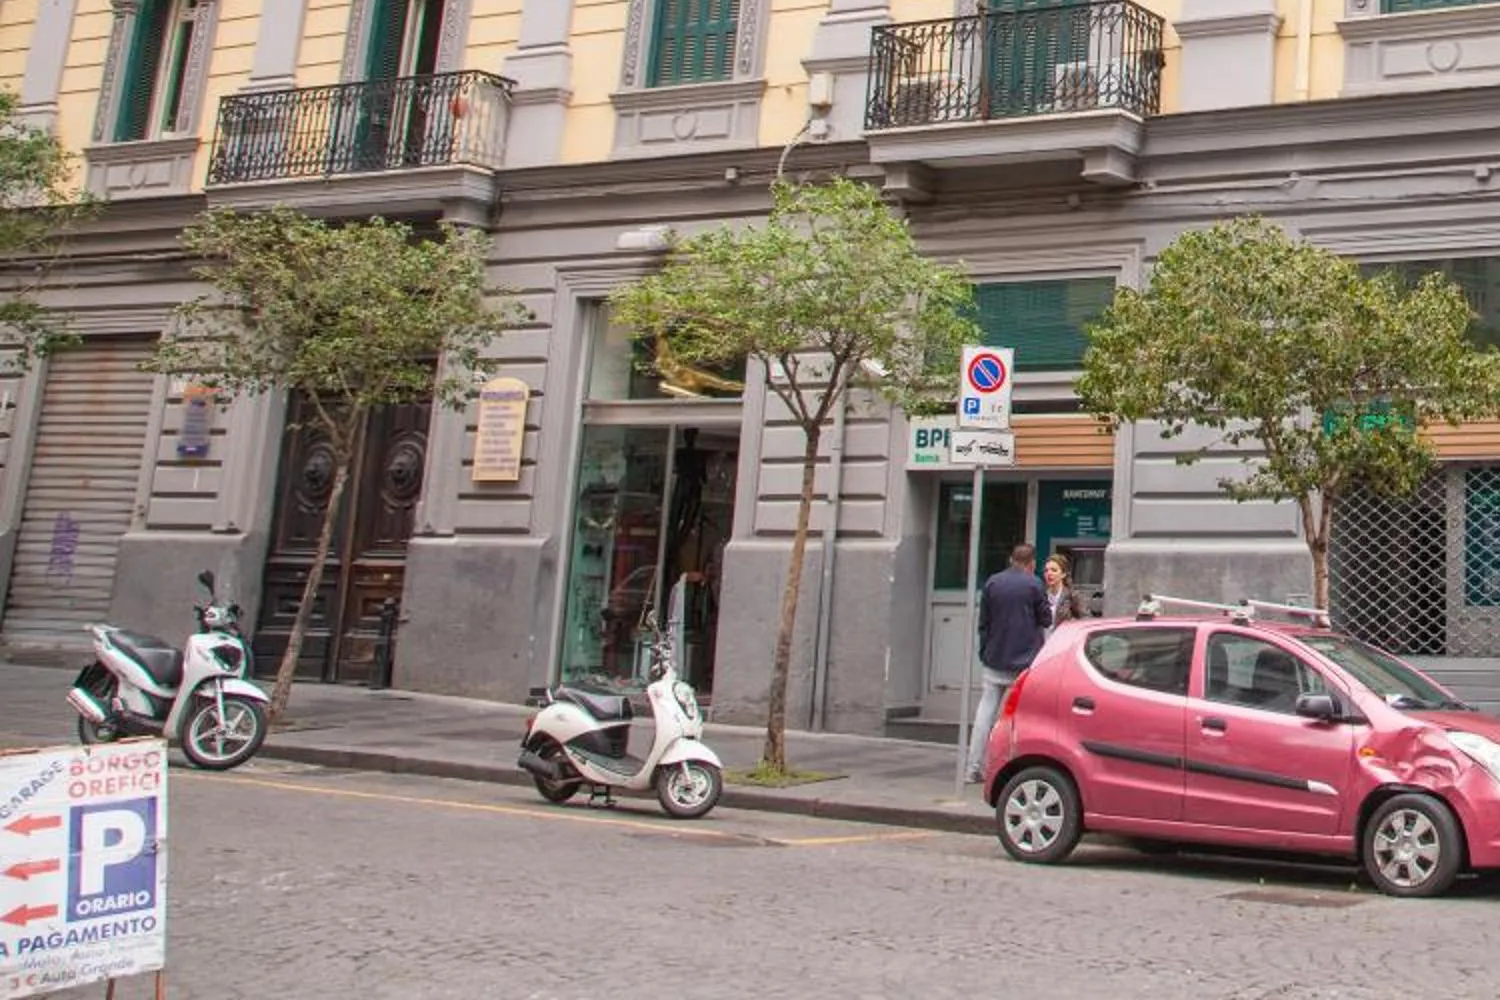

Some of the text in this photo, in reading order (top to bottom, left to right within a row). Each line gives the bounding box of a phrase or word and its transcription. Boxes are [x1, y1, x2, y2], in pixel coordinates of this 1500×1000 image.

[69, 751, 161, 777] BORGO
[0, 760, 65, 819] GARAGE
[68, 772, 160, 798] OREFICI
[80, 810, 146, 896] P
[76, 891, 150, 915] ORARIO
[17, 916, 157, 955] PAGAMENTO
[40, 969, 77, 985] Auto
[80, 957, 135, 975] Grande
